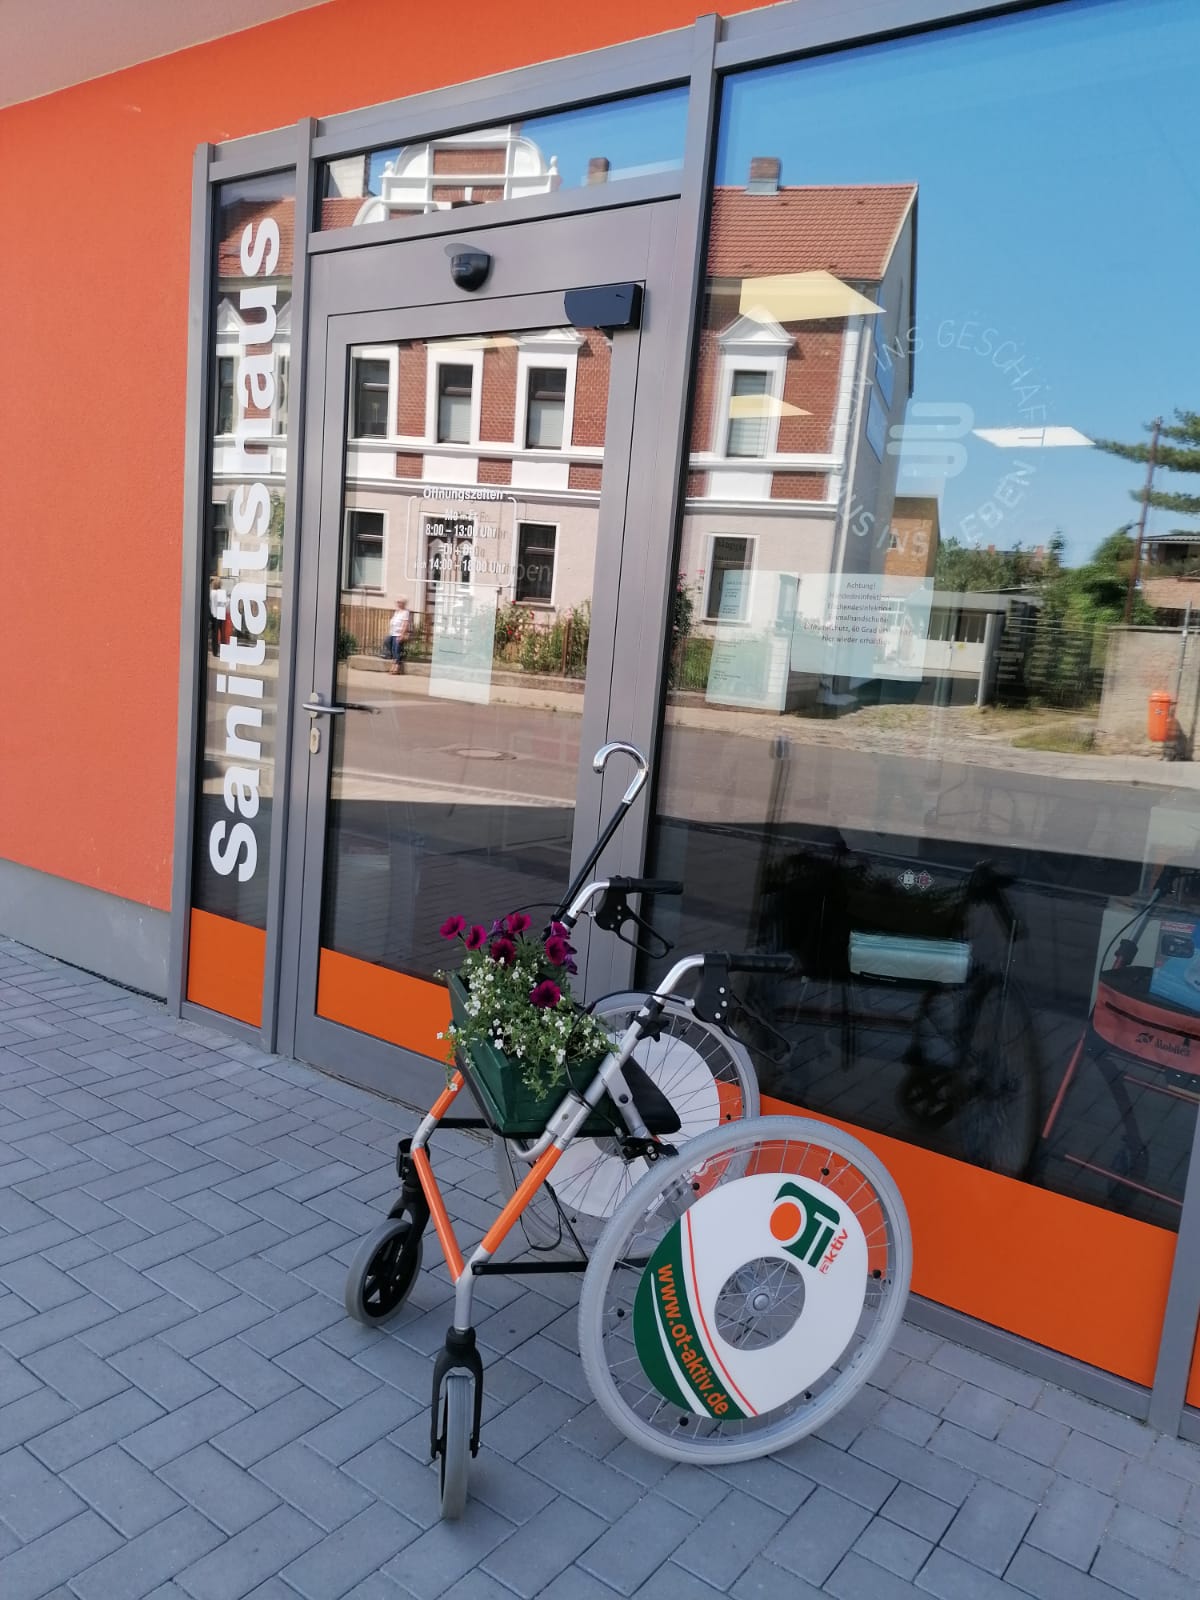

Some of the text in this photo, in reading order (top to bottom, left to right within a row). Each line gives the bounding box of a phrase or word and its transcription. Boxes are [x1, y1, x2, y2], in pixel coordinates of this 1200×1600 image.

[425, 524, 444, 536] 8:00
[480, 526, 497, 538] Uhr
[207, 217, 281, 882] Sanitätshaus
[429, 558, 452, 570] 14:00
[462, 560, 487, 572] 1800
[490, 561, 506, 574] Uhr
[846, 582, 876, 590] Achtung!
[657, 1263, 729, 1416] www.ot-aktiv.de
